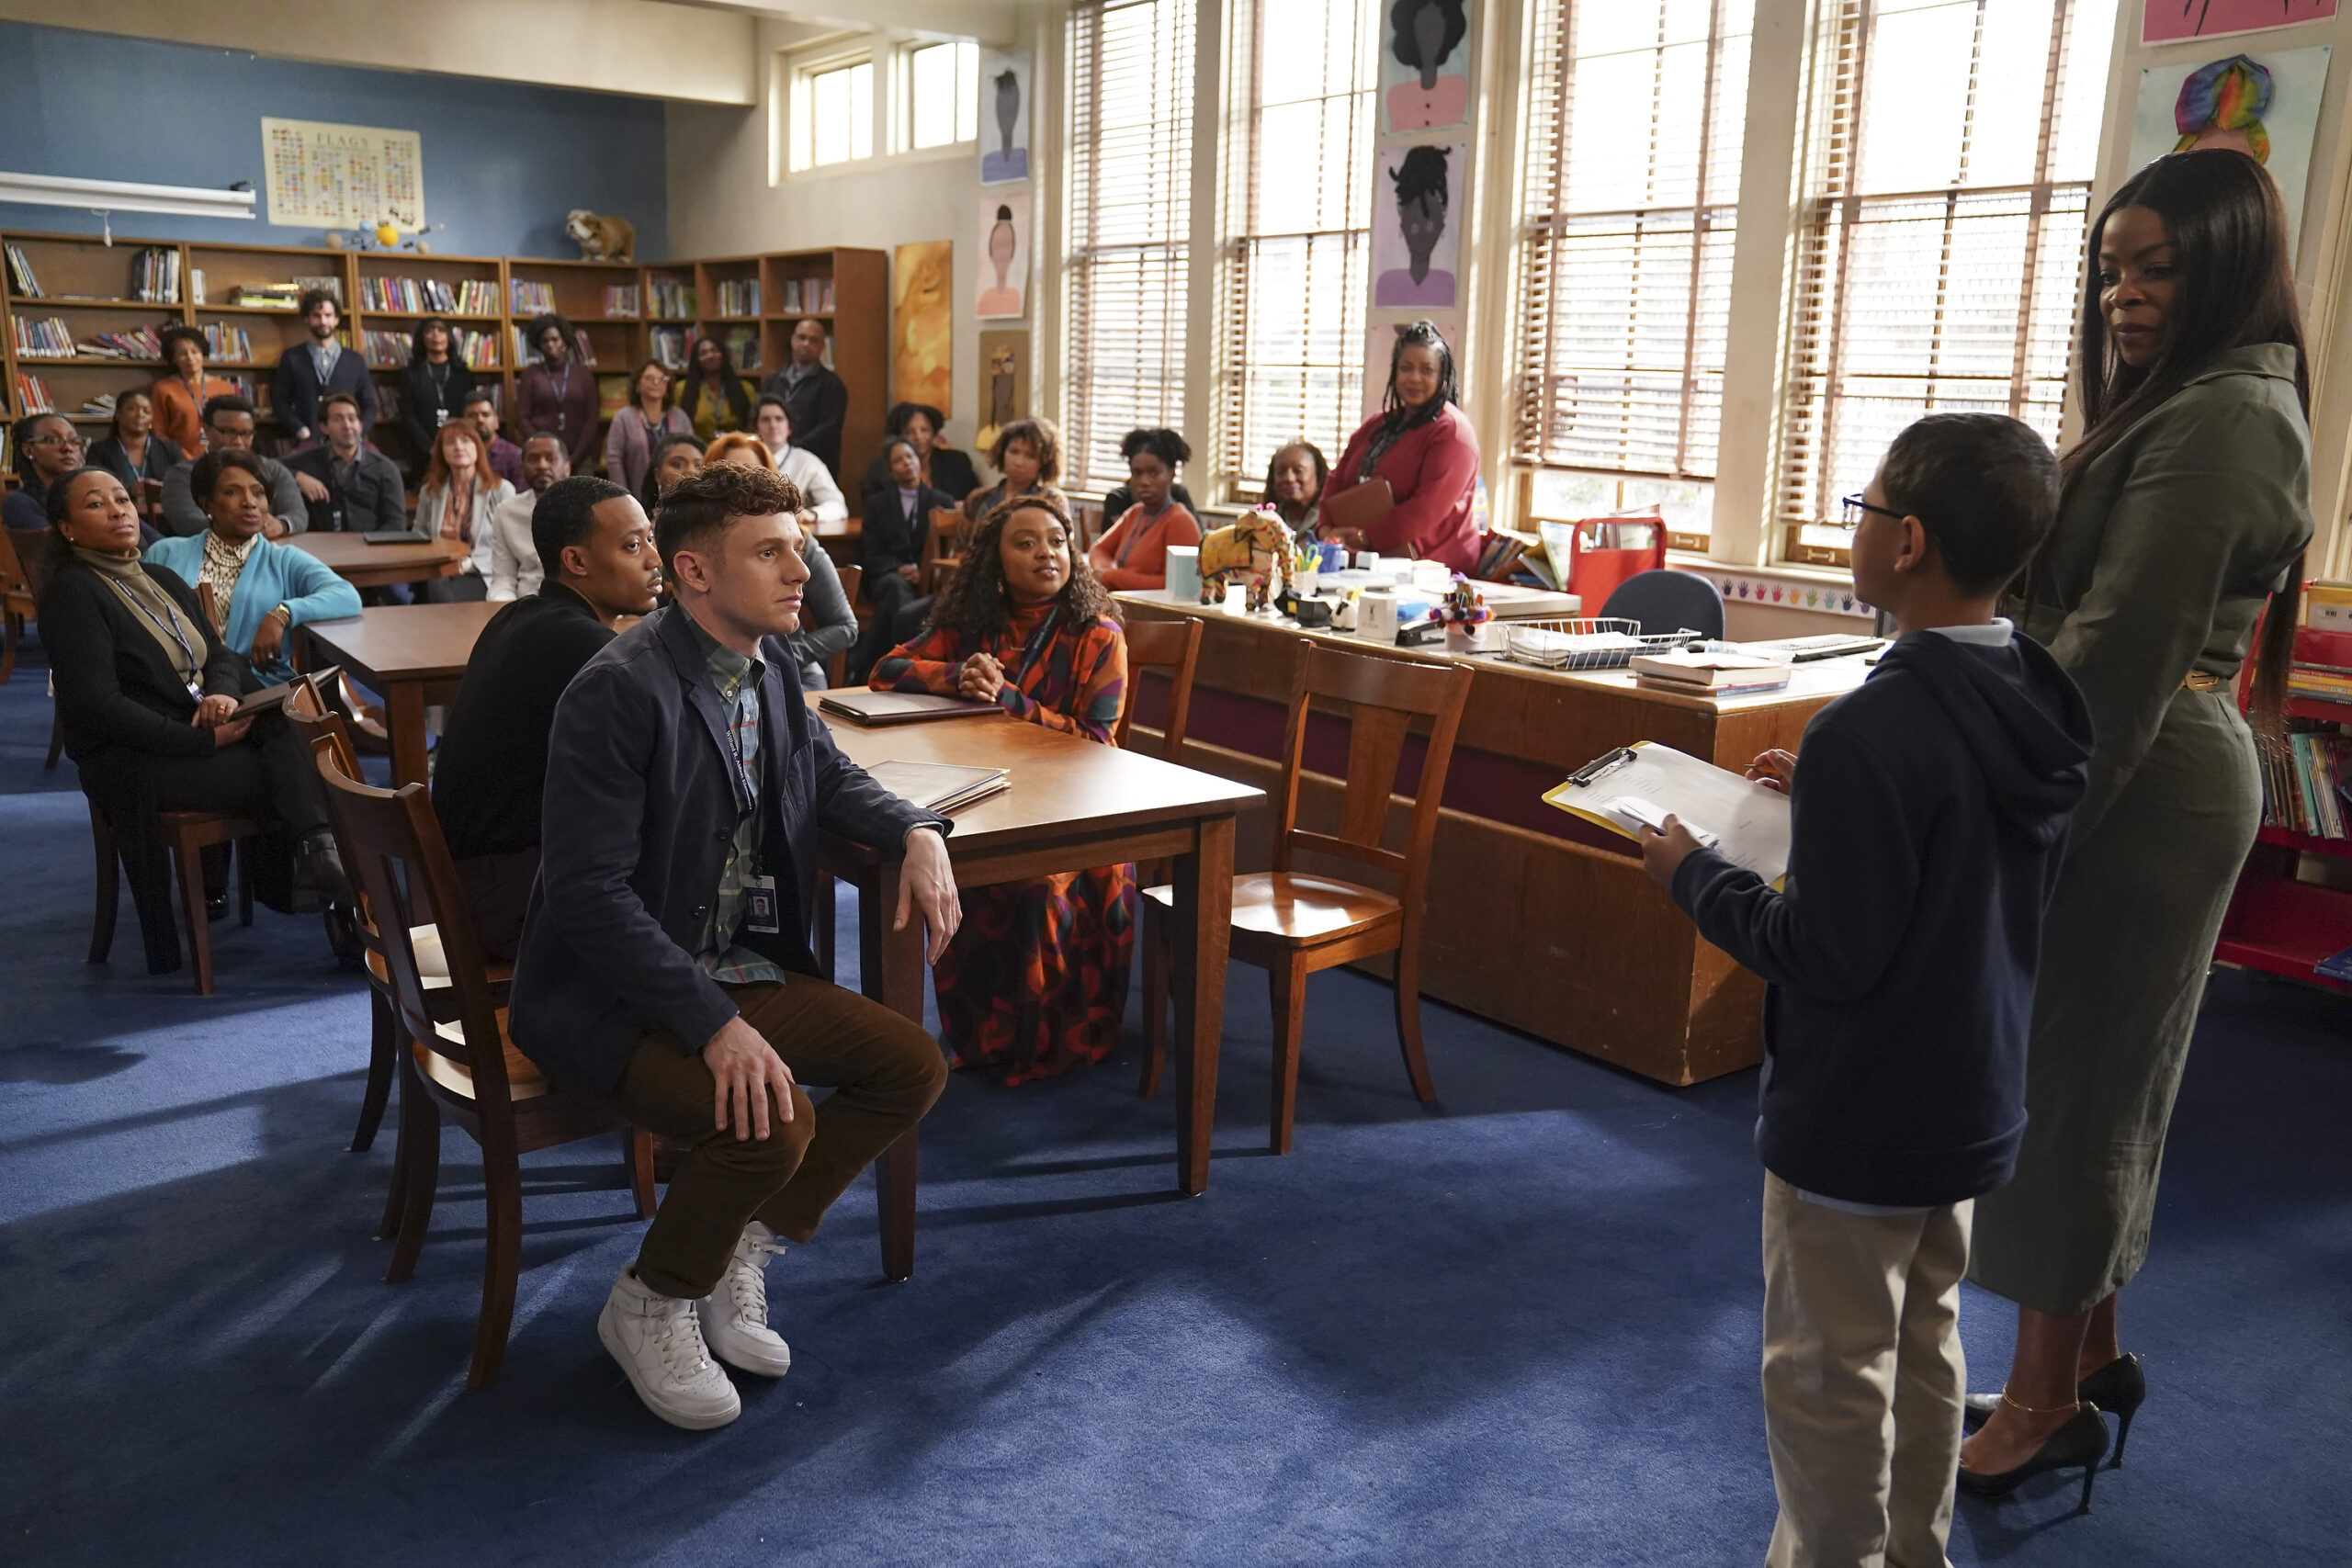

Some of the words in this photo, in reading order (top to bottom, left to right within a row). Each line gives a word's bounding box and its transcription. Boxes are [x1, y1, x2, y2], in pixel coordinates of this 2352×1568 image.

[317, 132, 368, 146] FLAGS
[727, 730, 737, 751] Willard
[735, 760, 744, 778] Abbott
